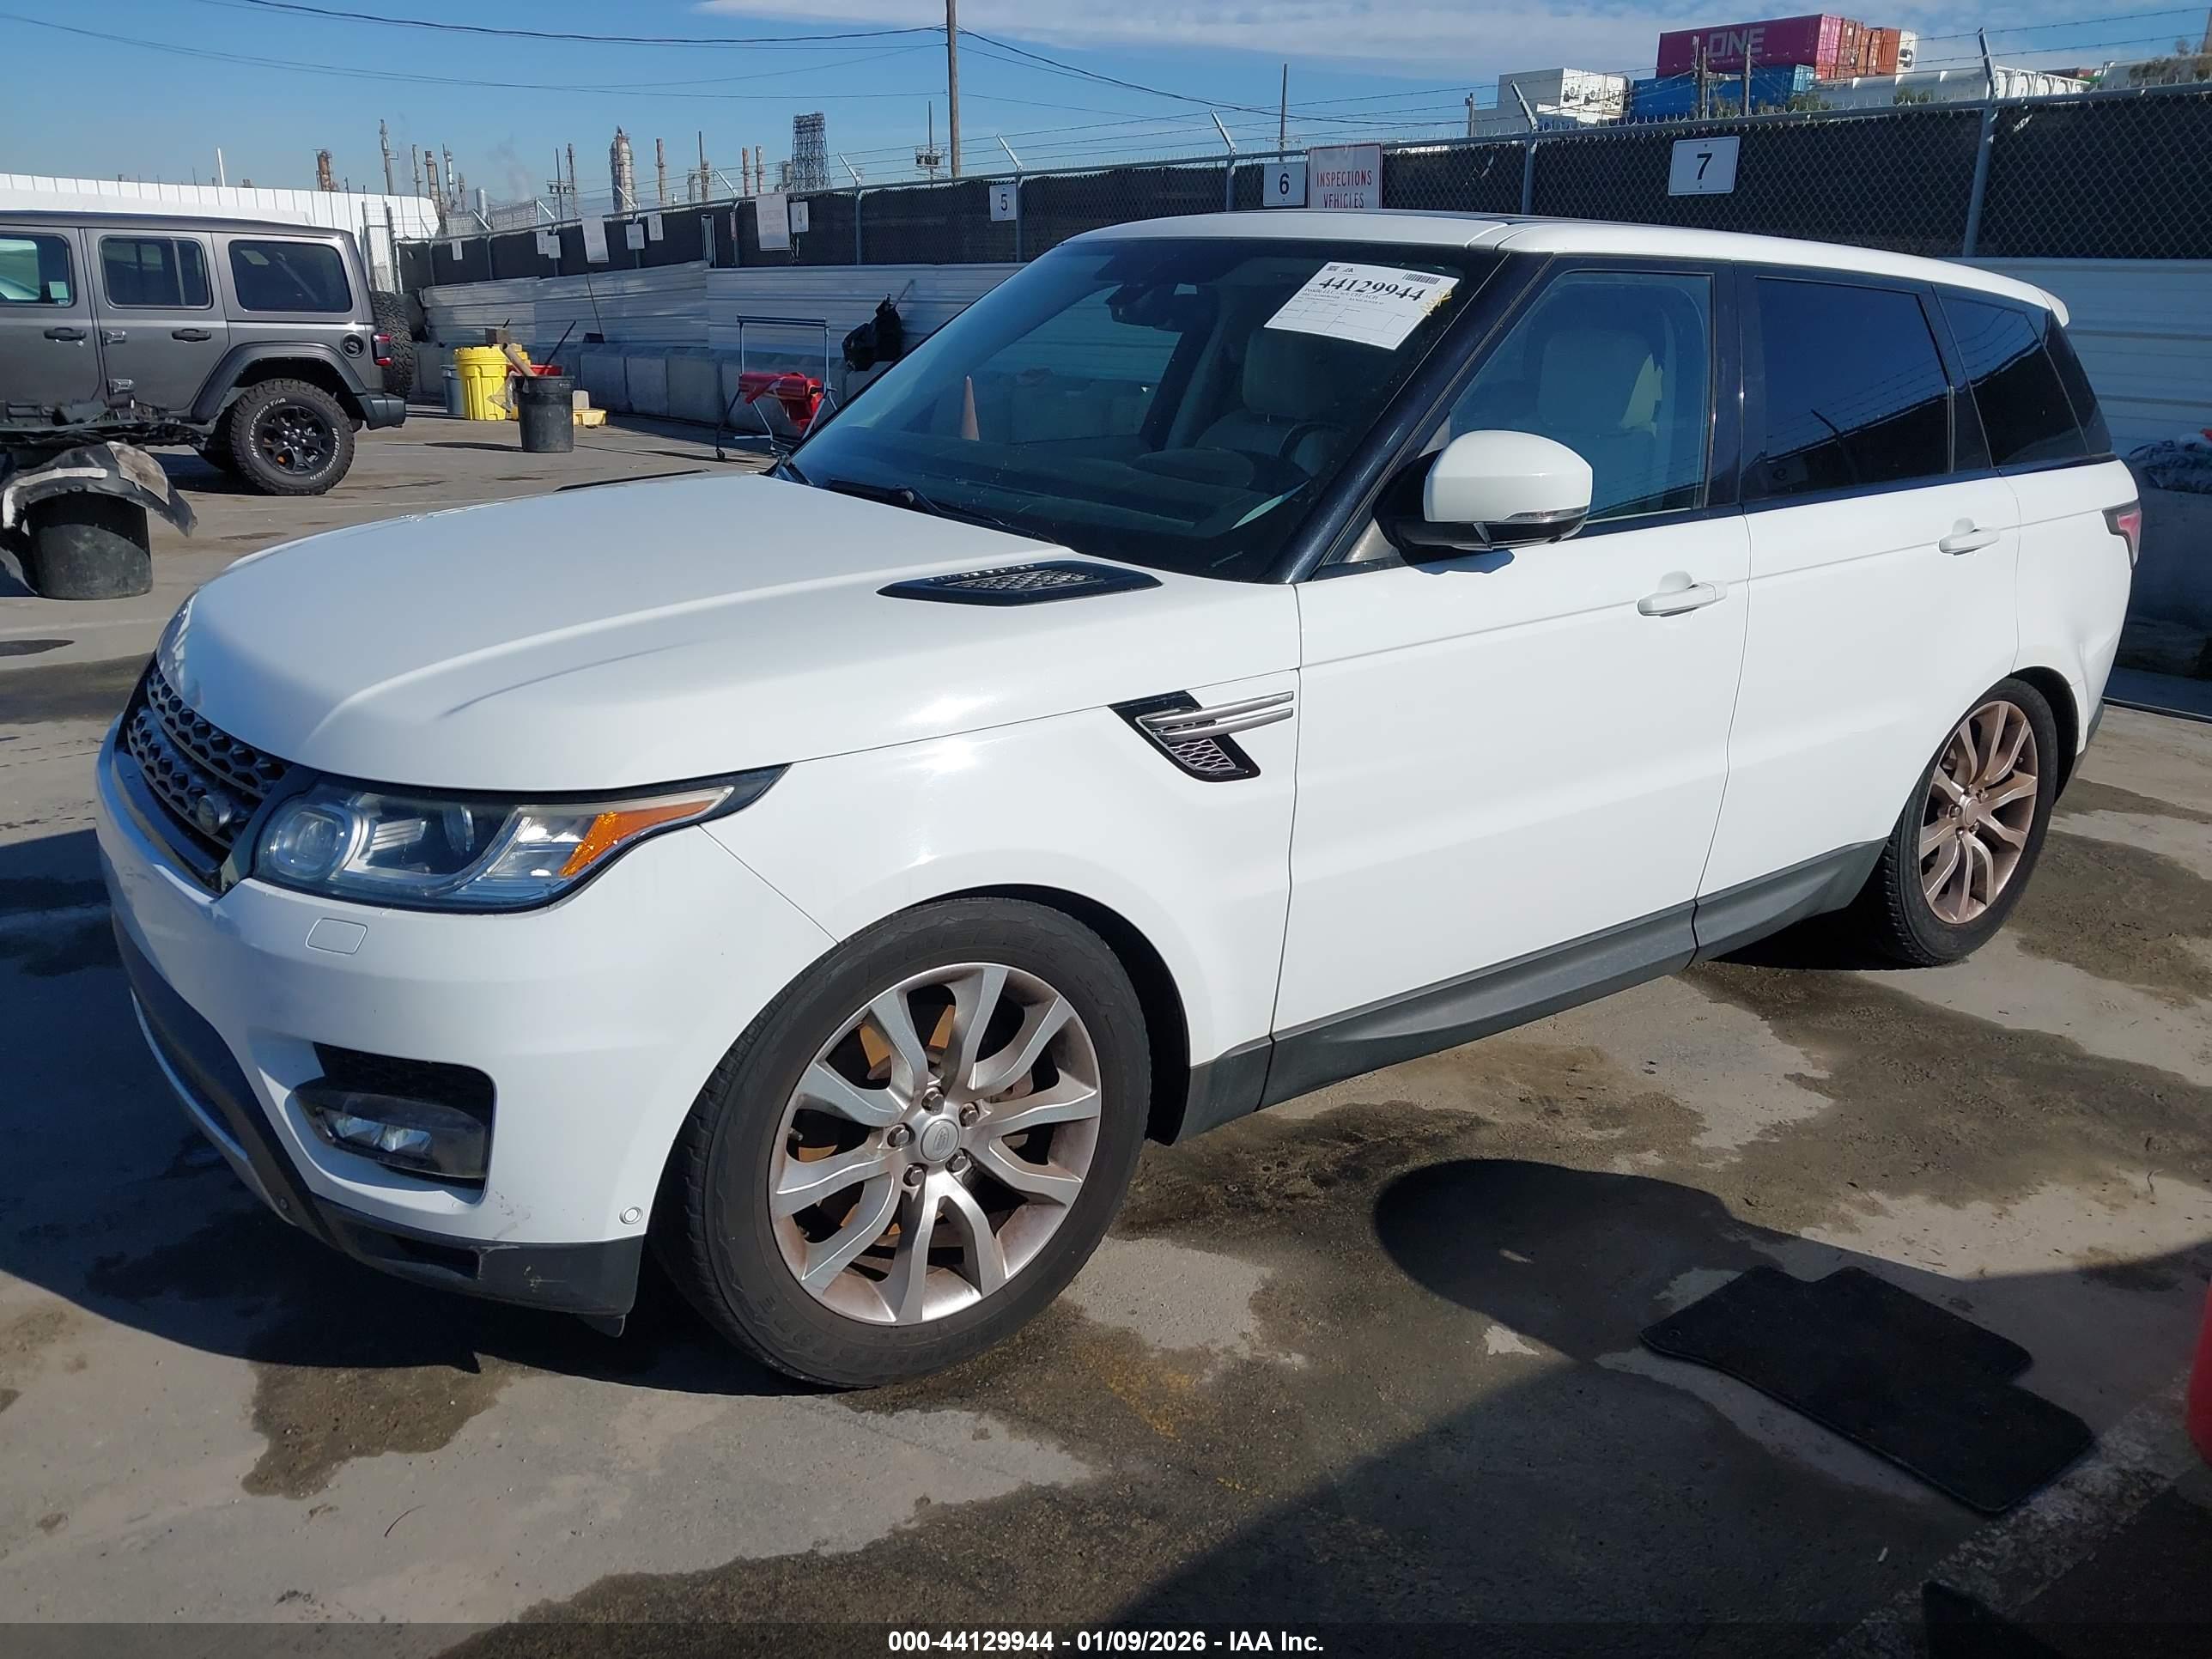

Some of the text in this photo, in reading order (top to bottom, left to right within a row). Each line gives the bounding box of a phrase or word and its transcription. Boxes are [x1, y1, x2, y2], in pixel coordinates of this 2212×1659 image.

[1707, 27, 1765, 58] ONE
[1697, 152, 1713, 180] 7
[1279, 173, 1290, 196] 6
[1316, 170, 1372, 187] INSPECTIONS
[1000, 193, 1008, 211] 5
[1323, 193, 1364, 209] VEHICLES
[797, 210, 803, 224] 4
[1318, 276, 1427, 301] 44129944
[270, 398, 287, 407] T/A
